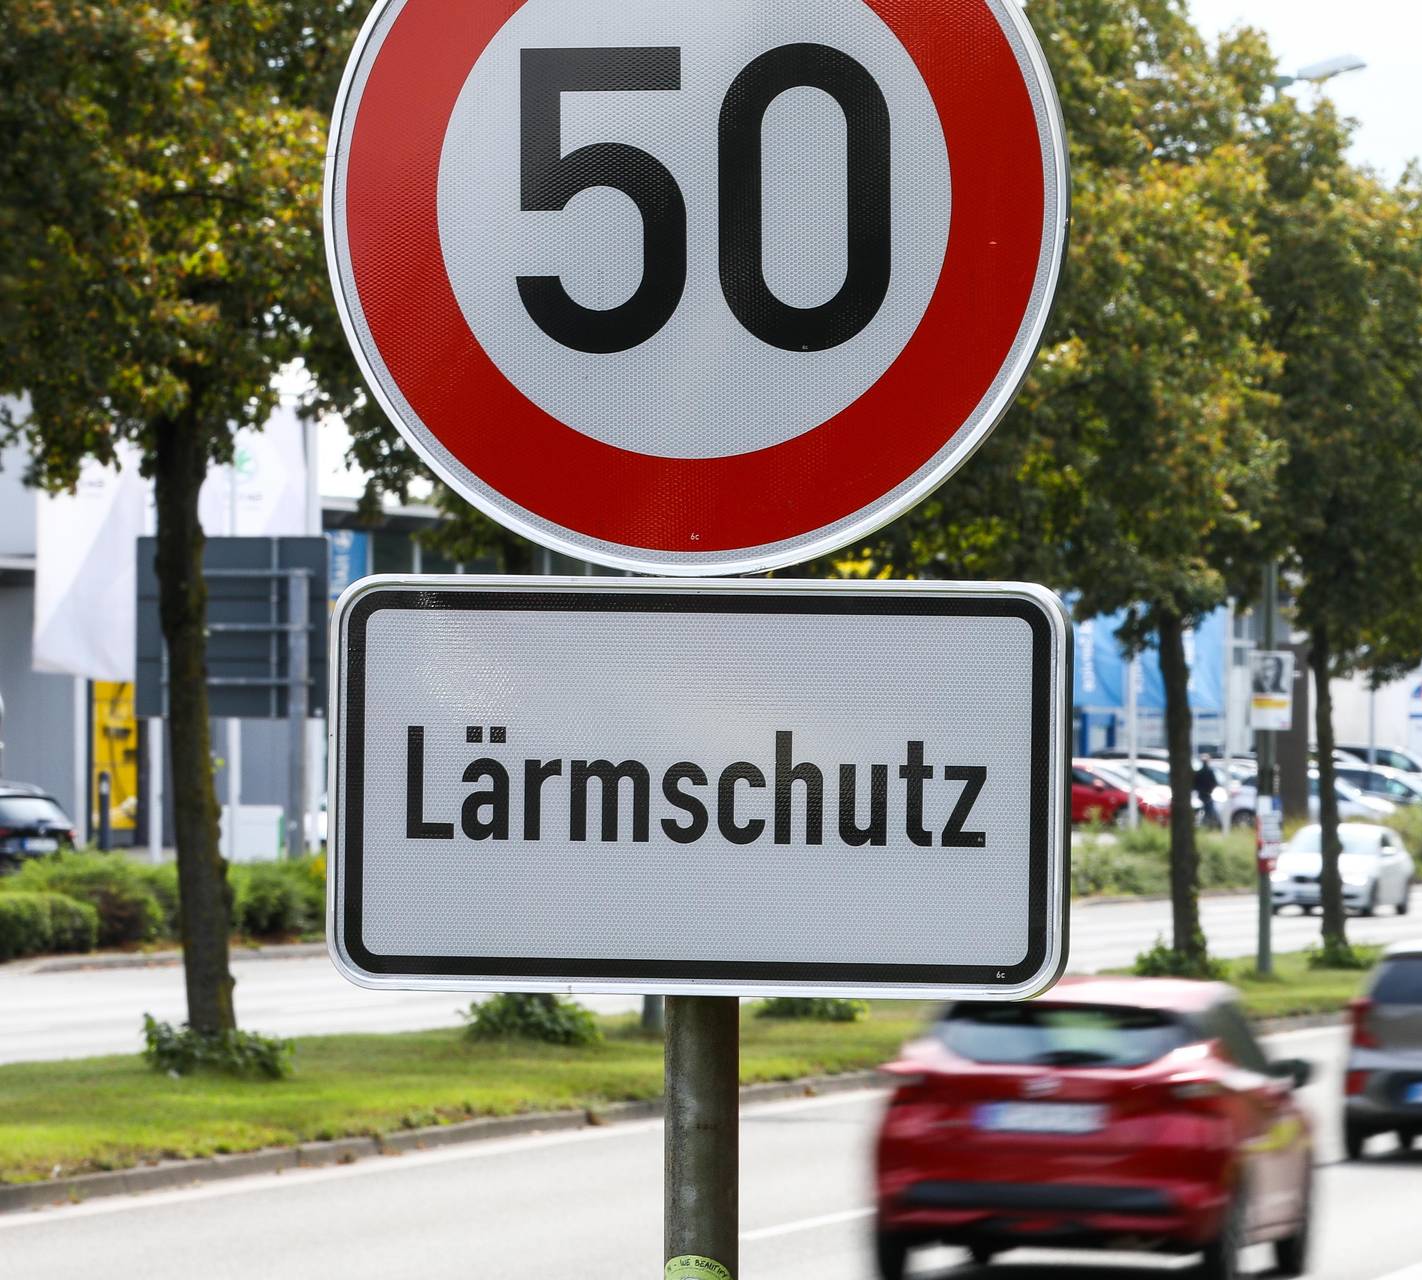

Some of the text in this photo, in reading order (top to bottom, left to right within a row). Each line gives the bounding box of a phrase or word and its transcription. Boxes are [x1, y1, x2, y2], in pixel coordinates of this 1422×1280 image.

[516, 42, 891, 354] 50
[690, 532, 700, 541] 6c
[406, 725, 988, 848] Lärmschutz
[996, 971, 1006, 979] 6c
